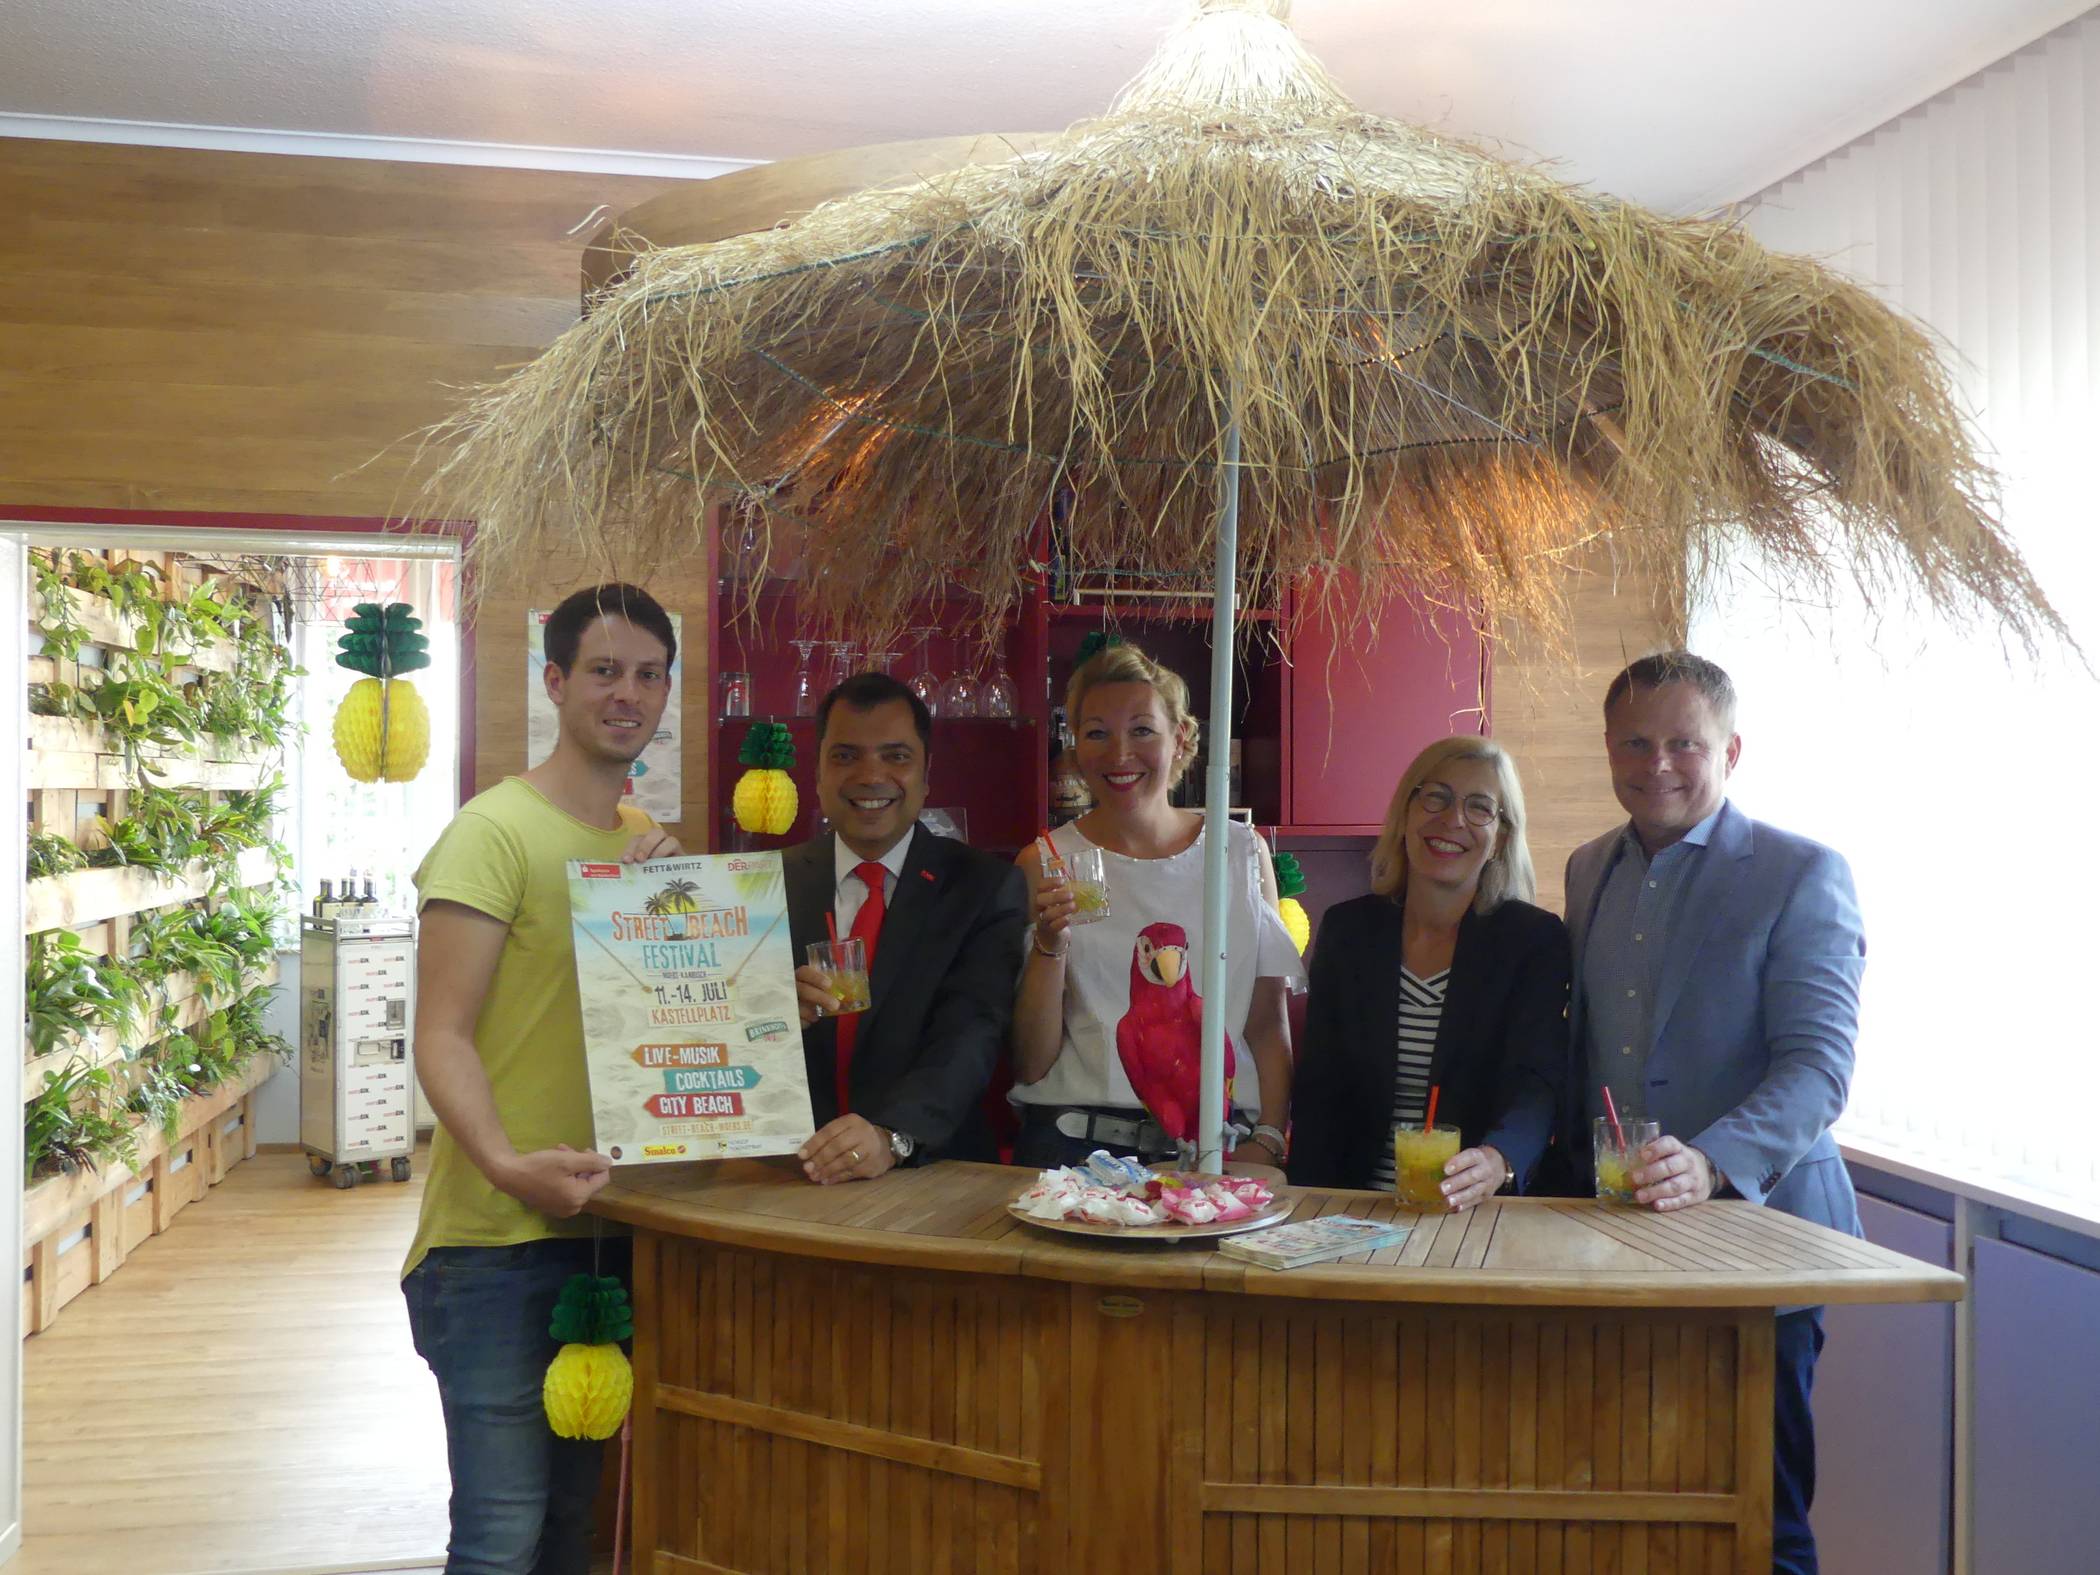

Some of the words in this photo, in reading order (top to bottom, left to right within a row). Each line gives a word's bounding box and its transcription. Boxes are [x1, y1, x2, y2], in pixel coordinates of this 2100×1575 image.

[643, 862, 702, 873] FETT&WIRTZ
[611, 911, 670, 941] STREET
[688, 906, 749, 940] BEACH
[642, 942, 721, 970] FESTIVAL
[702, 981, 728, 1002] JULI
[651, 1005, 731, 1025] KASTELLPLATZ
[644, 1046, 721, 1066] LIVE-MUSIK
[675, 1069, 745, 1091] COCKTAILS
[659, 1096, 687, 1116] CITY
[693, 1095, 734, 1115] BEACH
